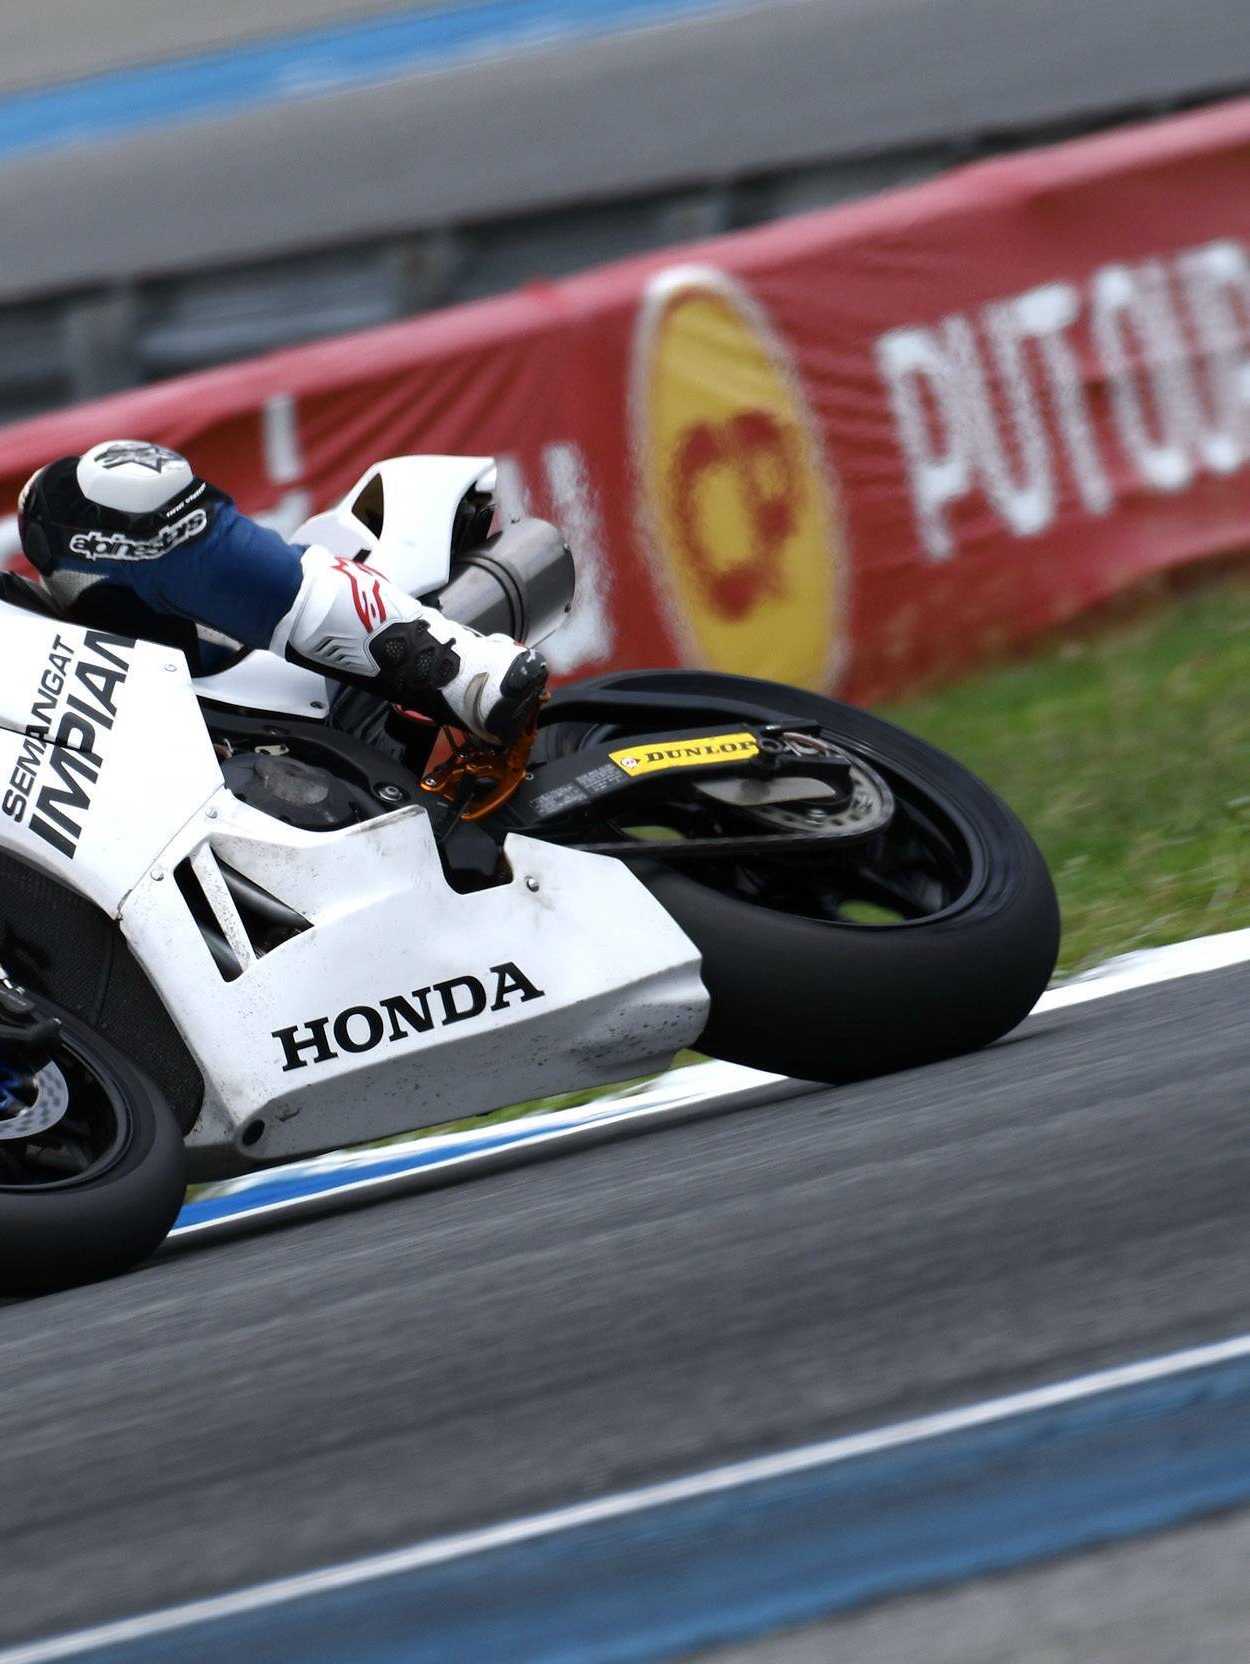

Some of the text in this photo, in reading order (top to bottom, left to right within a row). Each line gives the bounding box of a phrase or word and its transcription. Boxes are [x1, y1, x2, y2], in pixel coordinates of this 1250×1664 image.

[1, 634, 75, 823] SEMANGAT
[646, 741, 752, 763] DUNLOP
[271, 961, 546, 1072] HONDA
